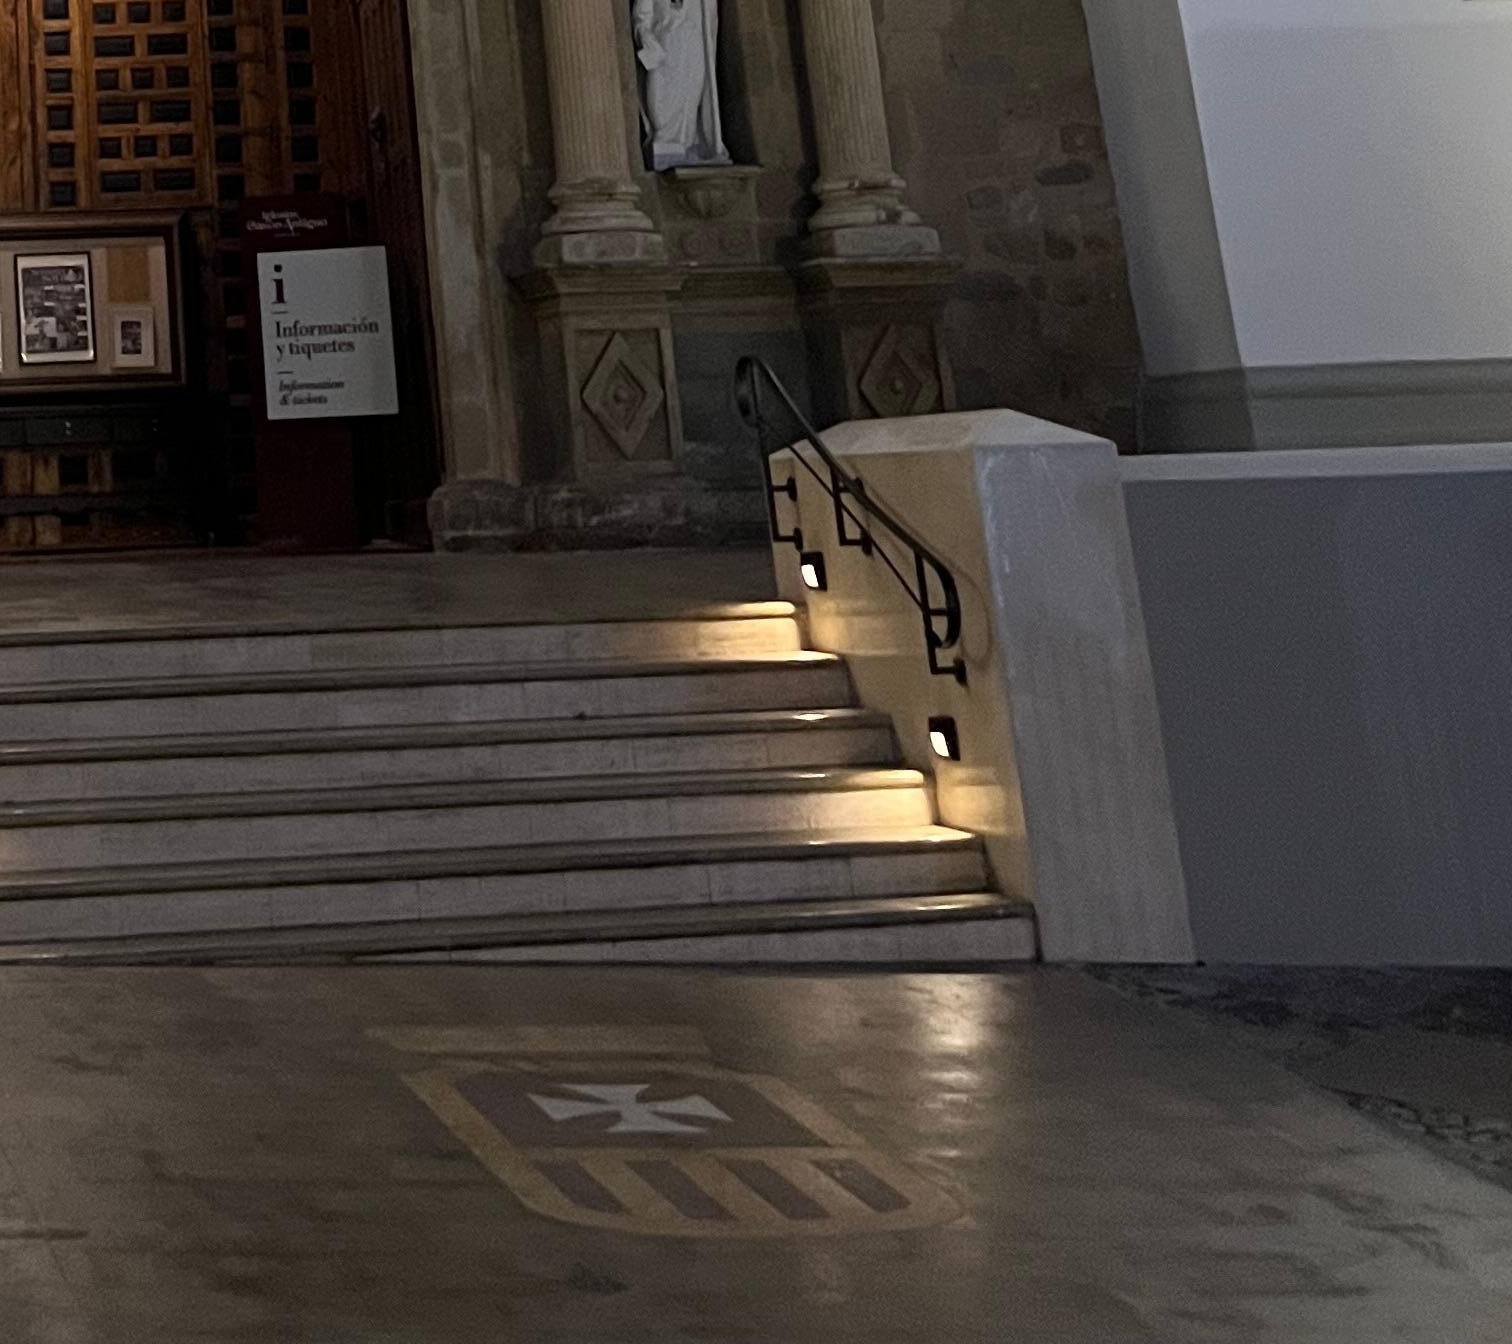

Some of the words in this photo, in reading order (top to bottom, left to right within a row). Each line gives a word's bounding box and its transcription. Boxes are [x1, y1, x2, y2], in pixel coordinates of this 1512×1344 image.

[275, 316, 380, 338] Información
[277, 344, 286, 362] y
[289, 340, 356, 360] tiquetes
